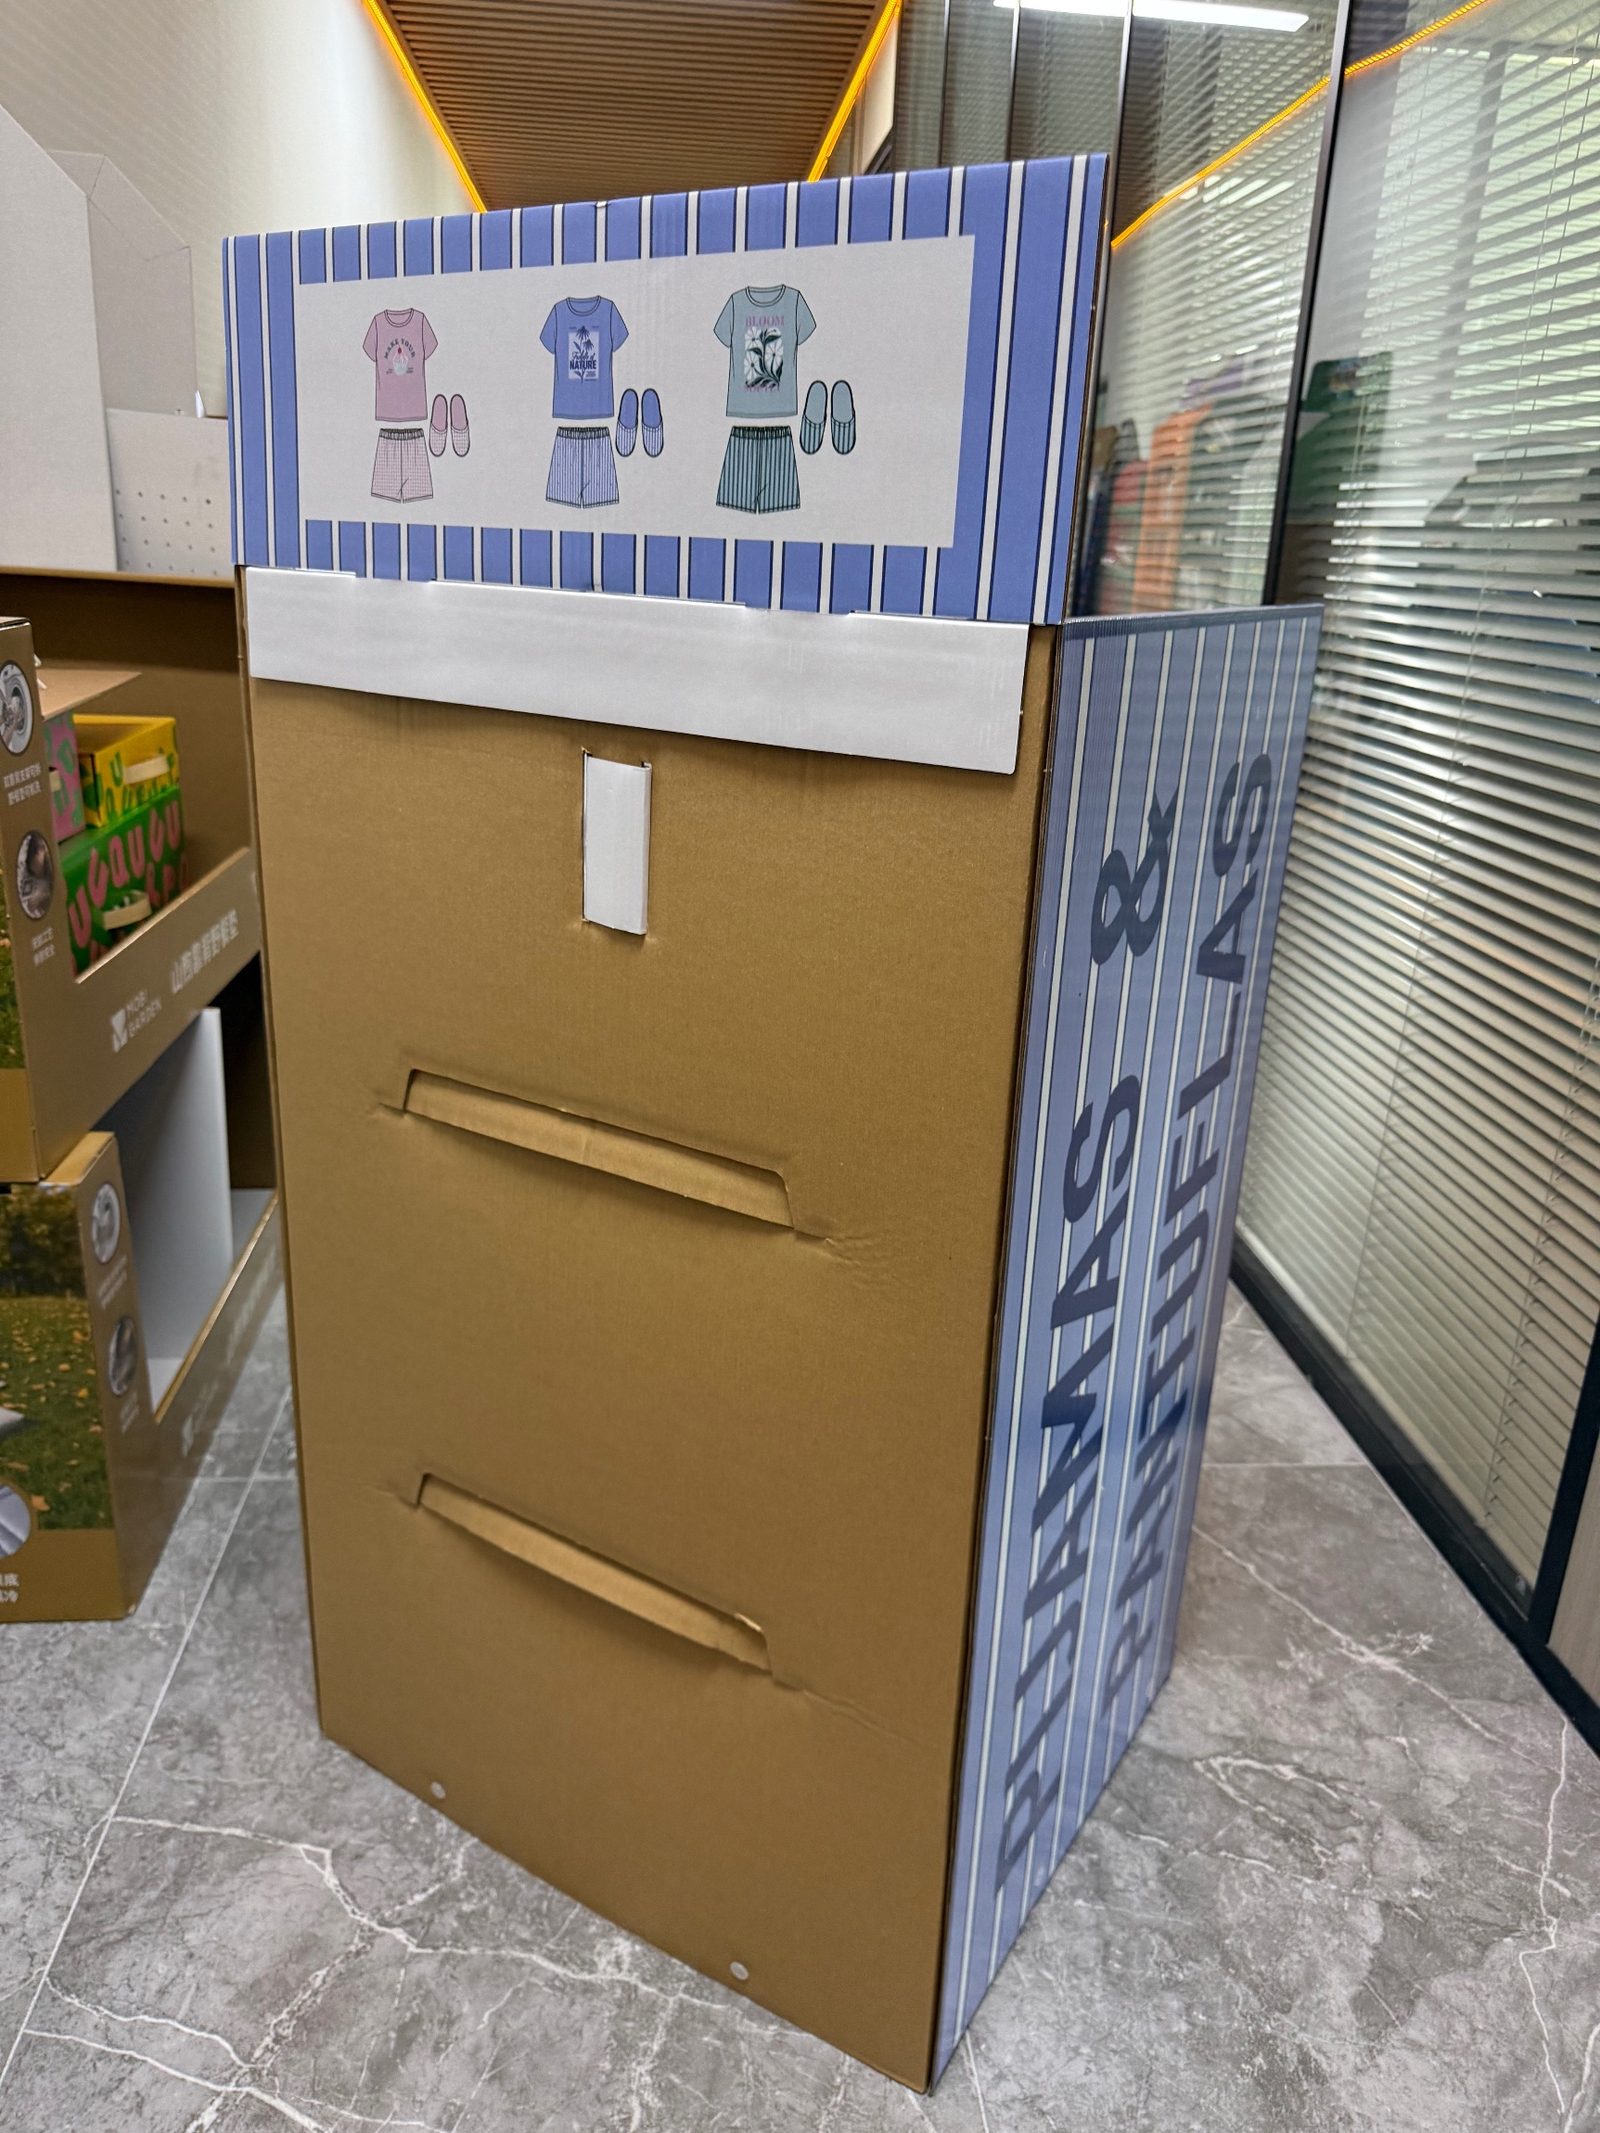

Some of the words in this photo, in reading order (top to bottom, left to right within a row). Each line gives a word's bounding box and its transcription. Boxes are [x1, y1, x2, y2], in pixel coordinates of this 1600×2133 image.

[745, 315, 785, 327] BLOOM
[384, 338, 399, 359] MAKE
[401, 338, 416, 358] YOUR
[570, 359, 597, 370] NATURE
[1101, 754, 1272, 1722] PANTUFLAS
[996, 1075, 1140, 1892] PIJAMAS
[1091, 786, 1180, 965] &
